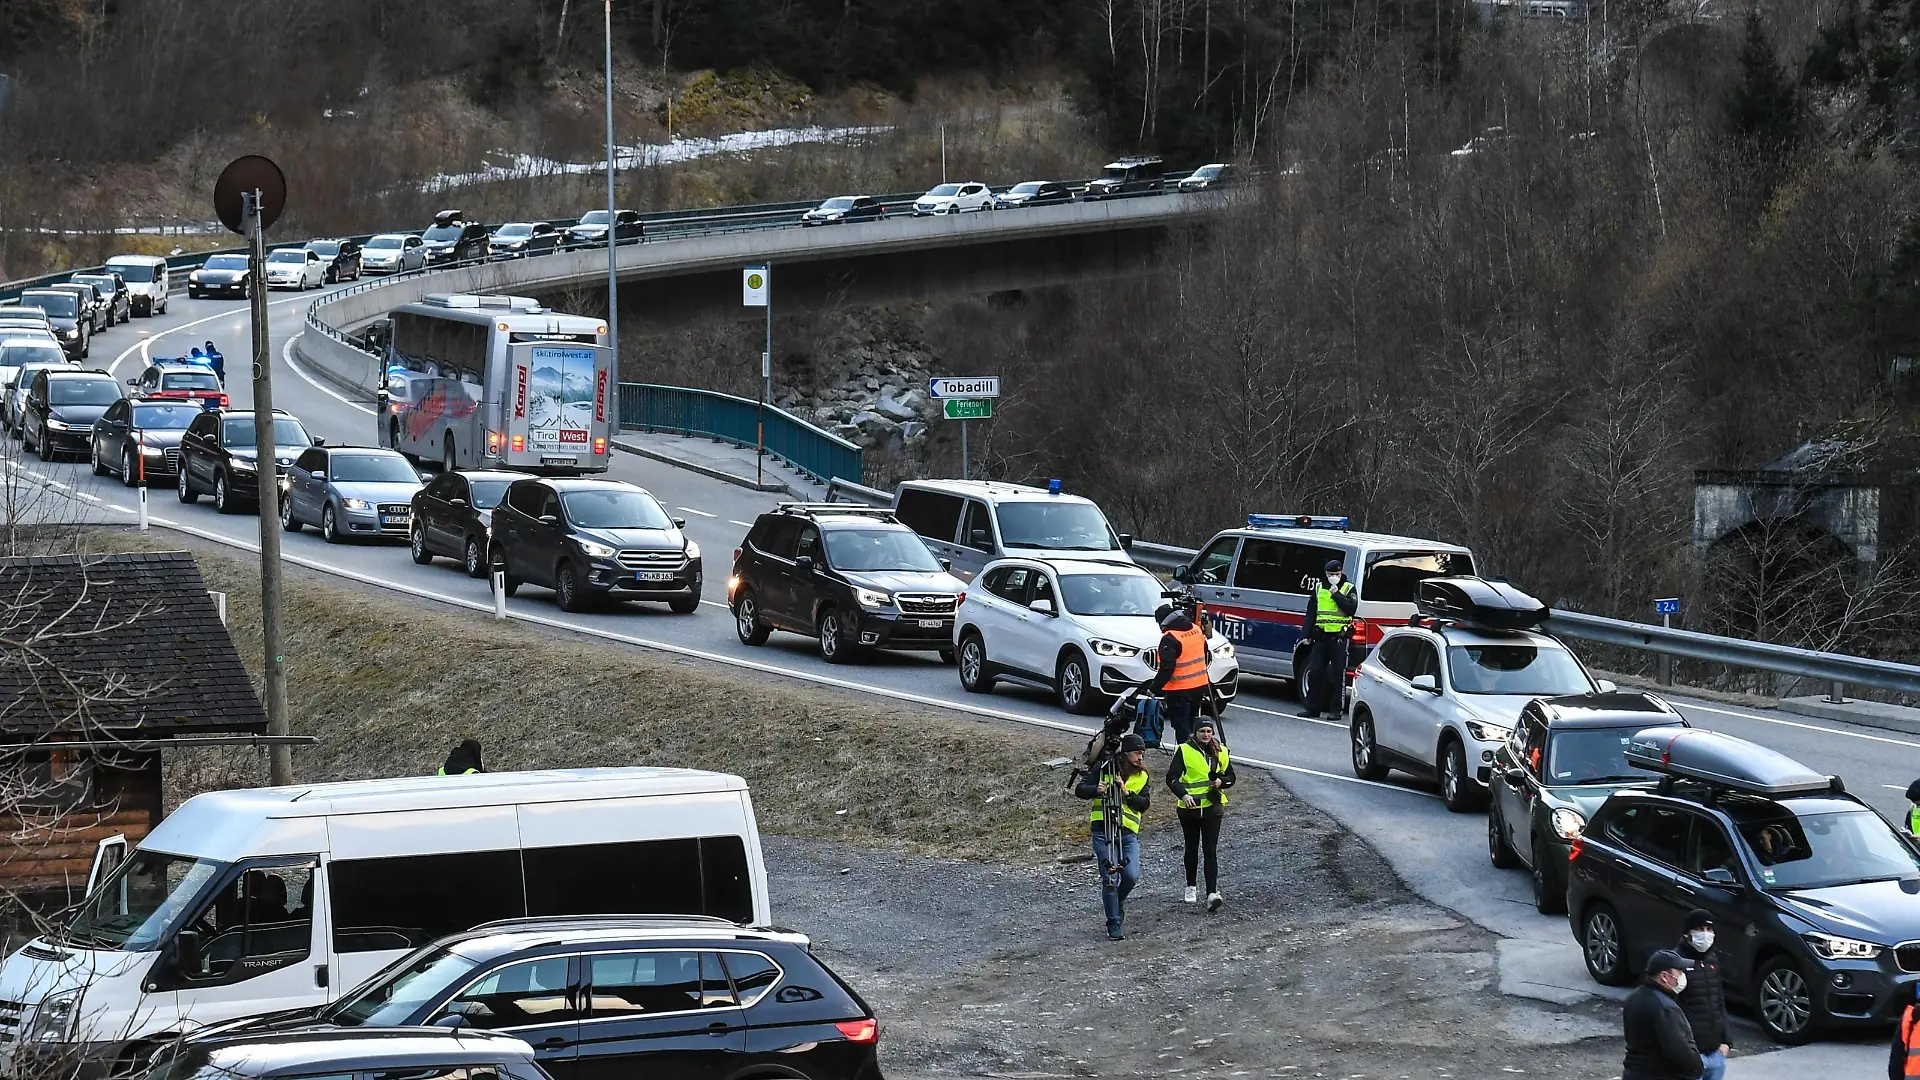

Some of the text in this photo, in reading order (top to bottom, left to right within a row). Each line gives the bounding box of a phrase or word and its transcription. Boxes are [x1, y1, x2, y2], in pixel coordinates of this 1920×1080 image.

[943, 381, 993, 393] Tobadill
[956, 400, 985, 408] Ferienort
[536, 431, 586, 441] Tirol West
[243, 959, 283, 968] TRANSIT
